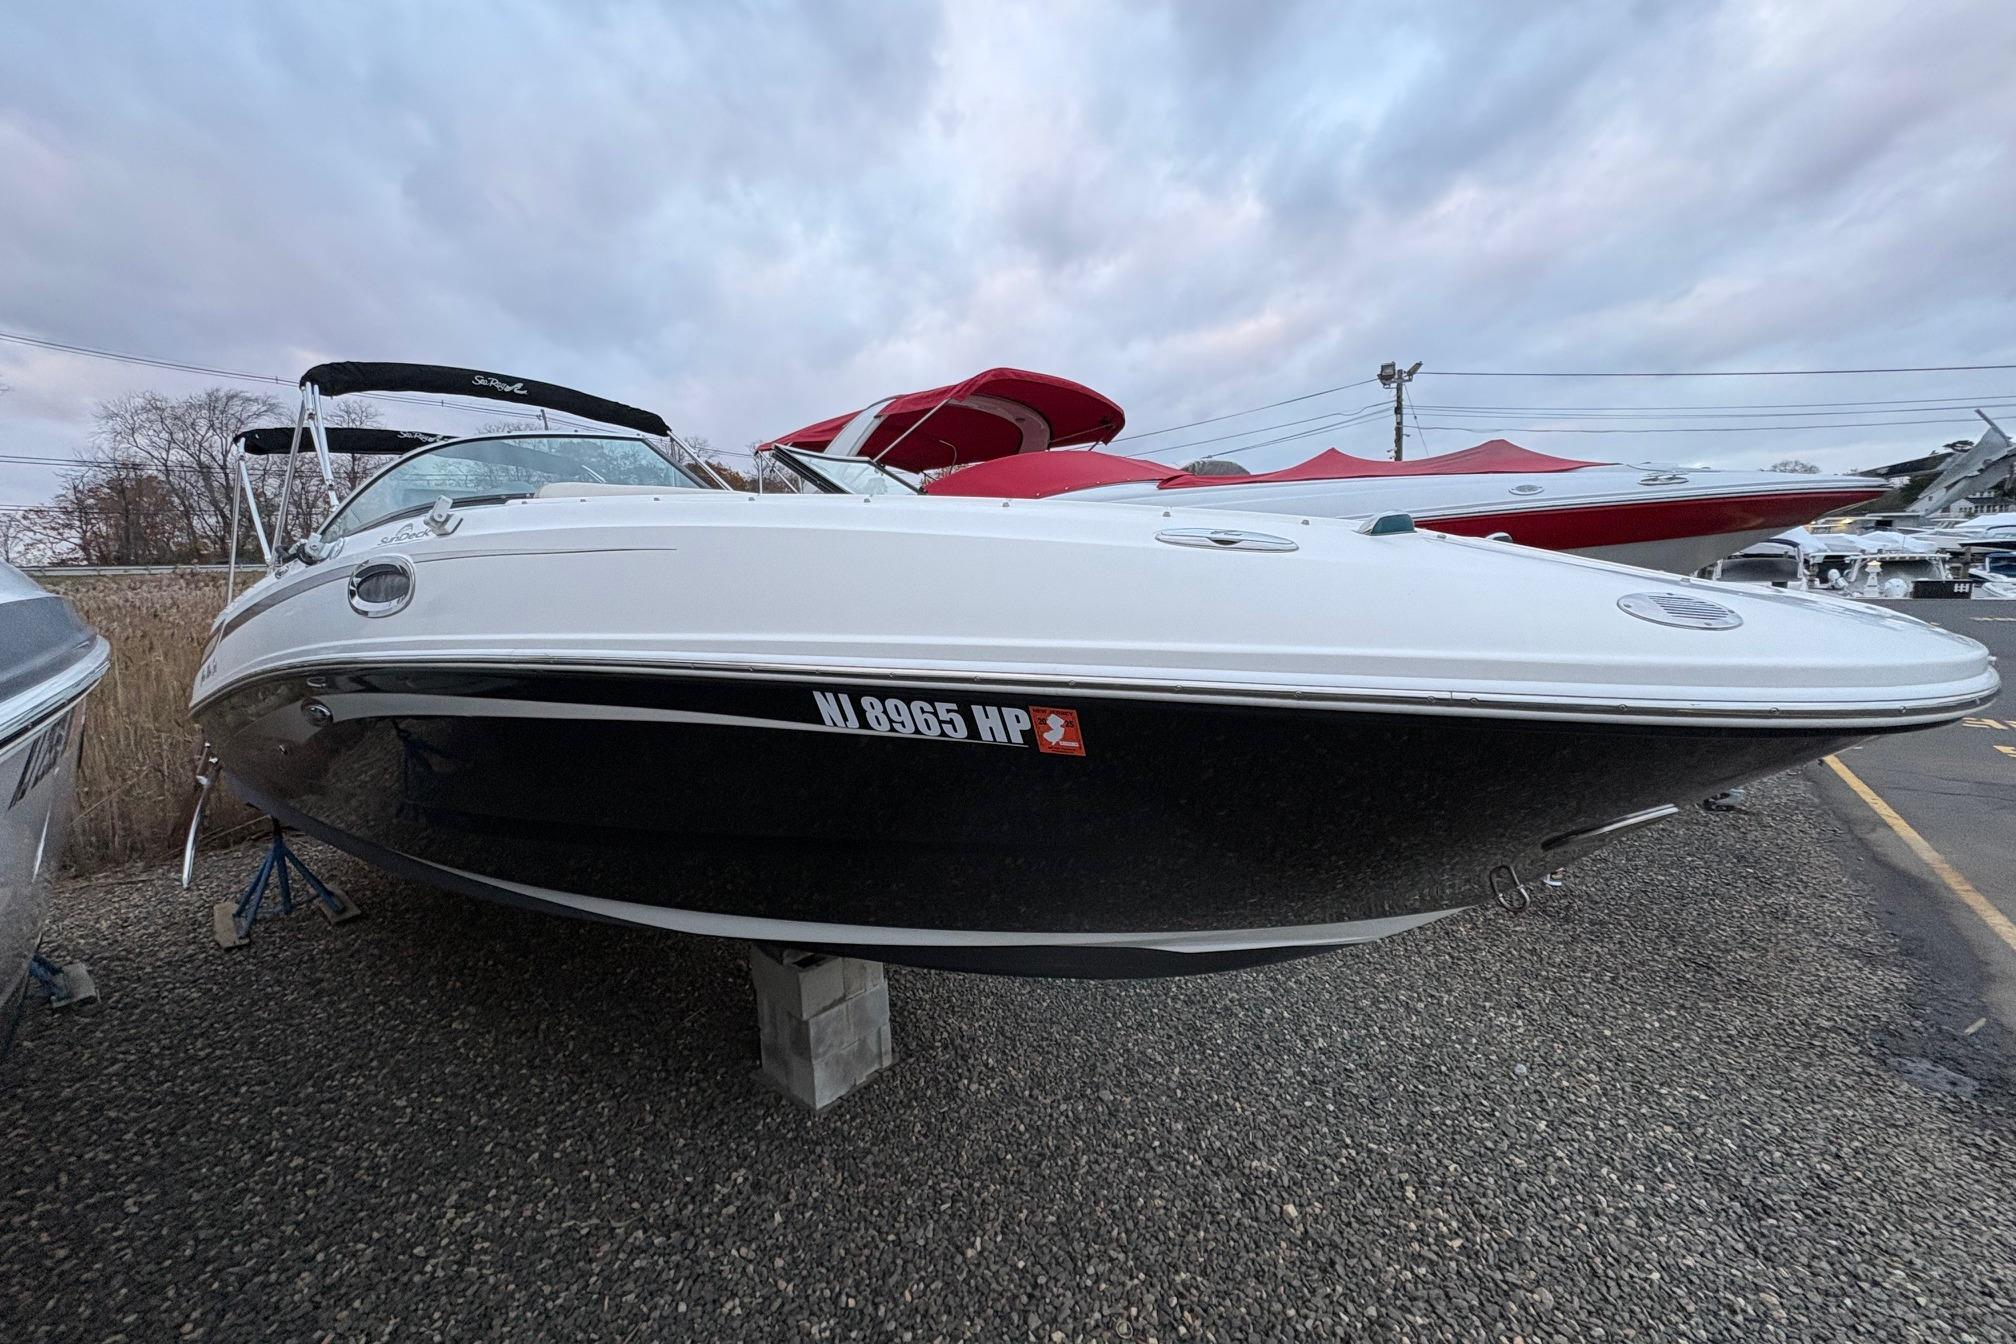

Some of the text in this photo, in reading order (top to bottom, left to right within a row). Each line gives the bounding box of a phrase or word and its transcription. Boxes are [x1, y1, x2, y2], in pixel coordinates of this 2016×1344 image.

[472, 375, 506, 392] Sea Ray
[812, 690, 1032, 745] NJ 8965 HP
[1064, 720, 1074, 728] 25
